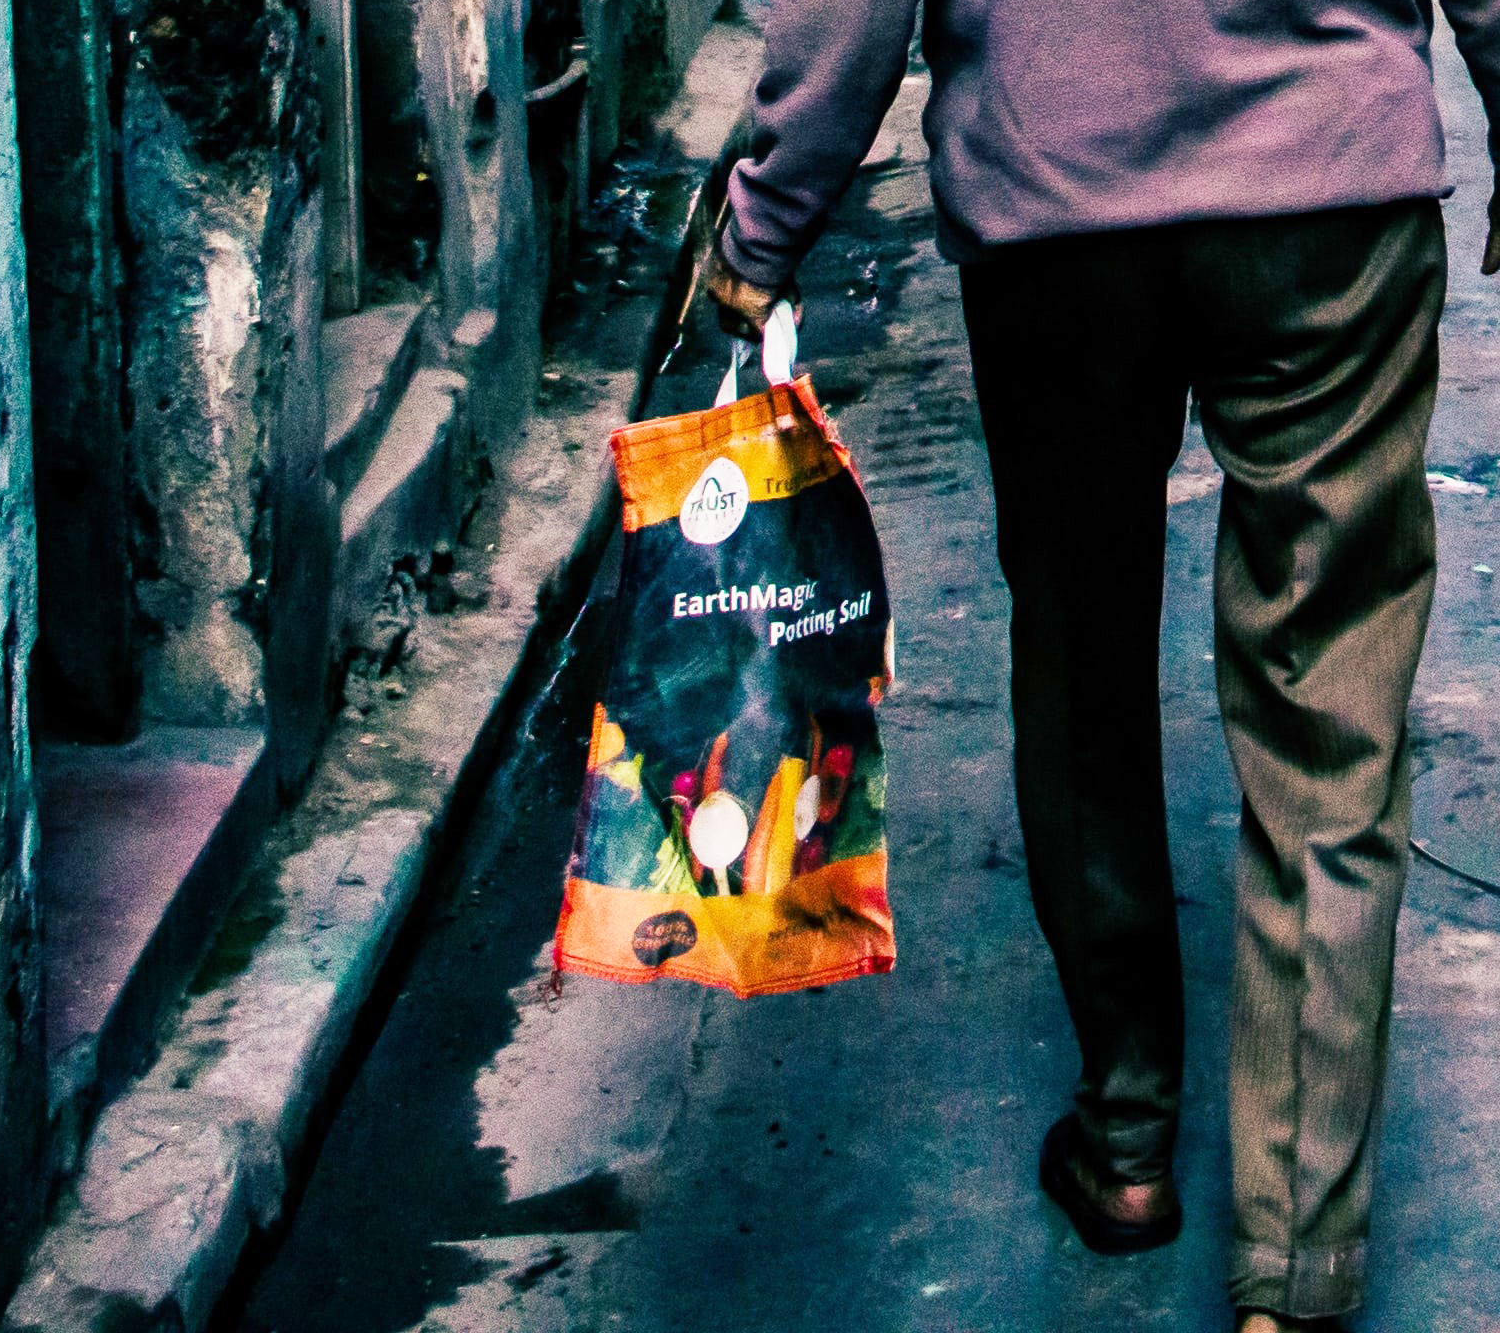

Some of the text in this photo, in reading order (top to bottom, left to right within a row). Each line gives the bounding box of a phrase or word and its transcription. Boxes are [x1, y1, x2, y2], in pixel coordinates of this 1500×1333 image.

[672, 581, 818, 618] EarthMagic
[769, 590, 872, 649] Potting Soil
